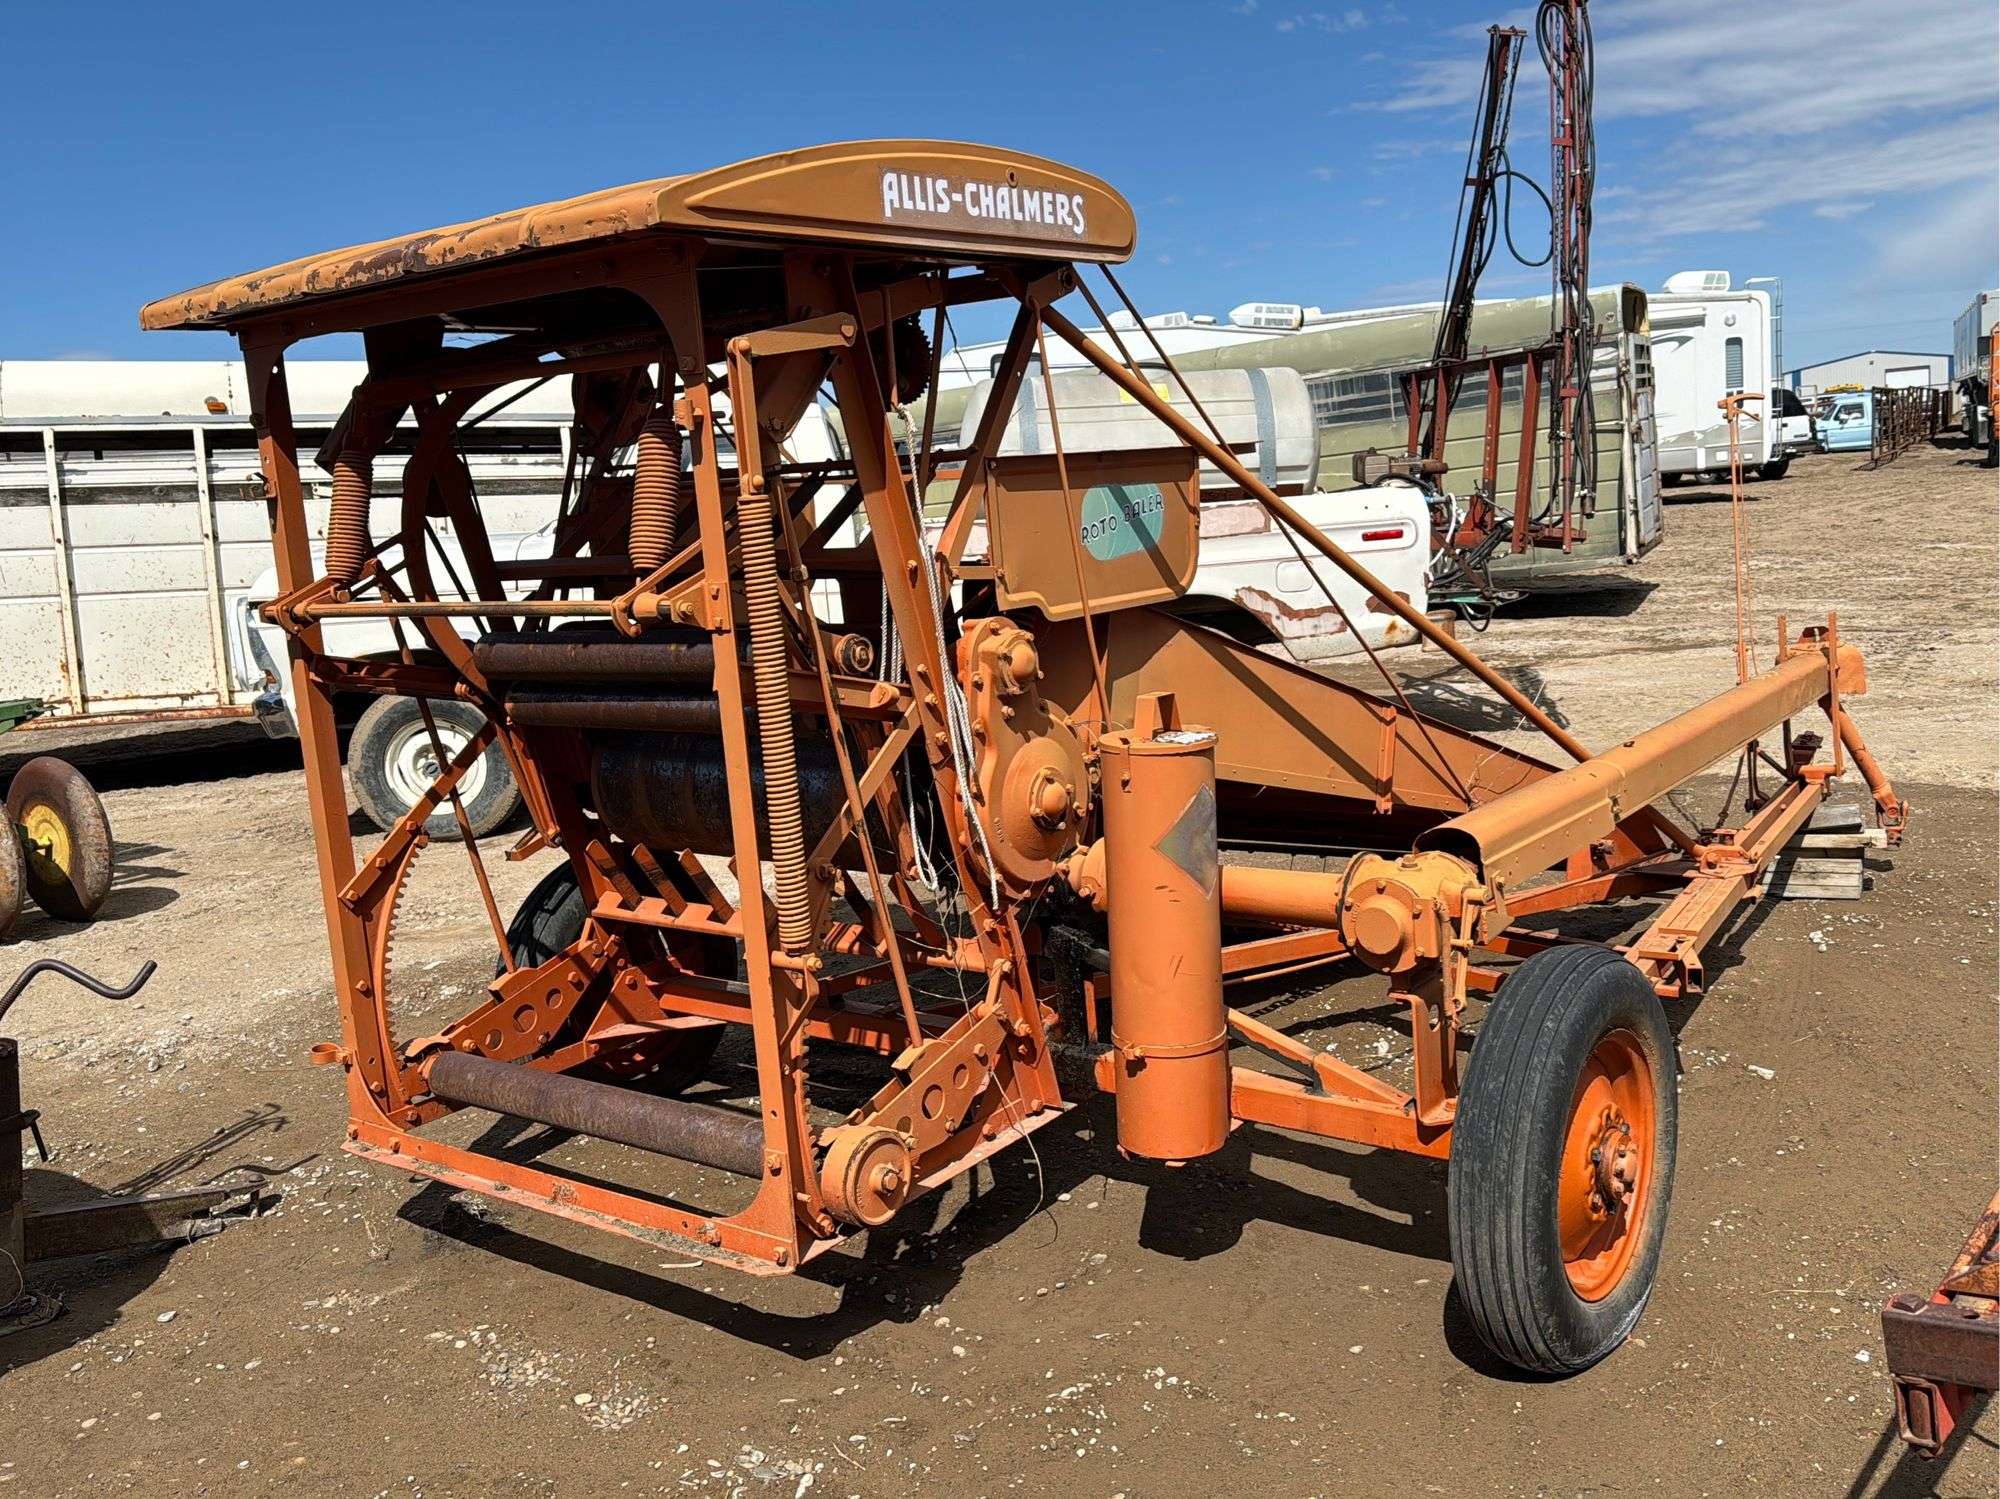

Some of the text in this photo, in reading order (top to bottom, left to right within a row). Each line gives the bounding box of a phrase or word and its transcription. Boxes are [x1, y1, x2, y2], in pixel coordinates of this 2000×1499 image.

[883, 173, 1085, 234] ALLIS-CHALMERS
[1081, 493, 1164, 545] ROTO BALER
